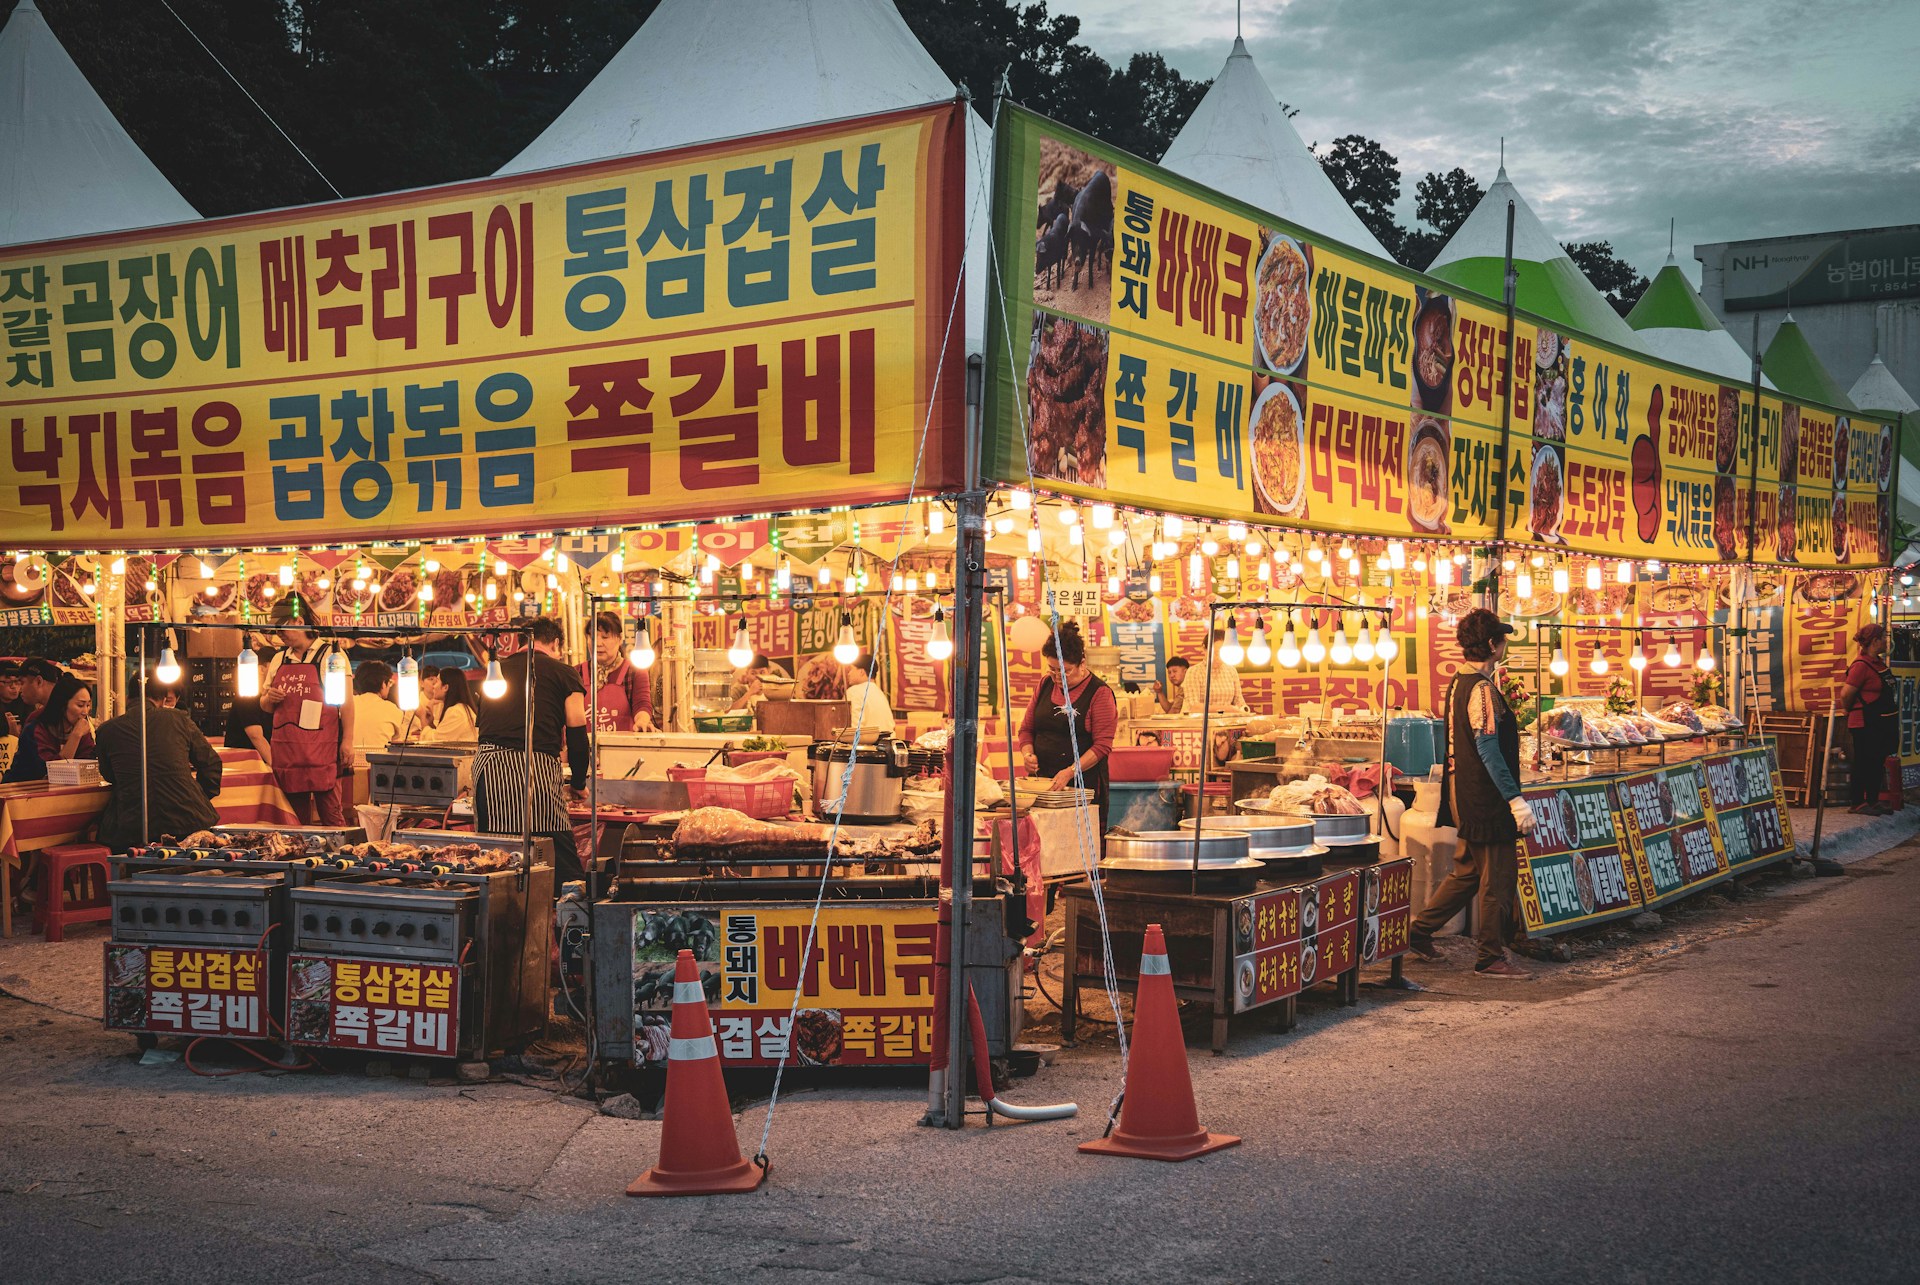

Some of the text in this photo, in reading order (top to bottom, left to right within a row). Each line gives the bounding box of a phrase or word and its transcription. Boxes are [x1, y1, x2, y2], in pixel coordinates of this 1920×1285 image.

[62, 142, 886, 383] 곰장어 메추리구이 통삼겹살
[1117, 190, 1154, 320] 통돼지
[1732, 254, 1769, 272] NH
[1, 264, 54, 388] 자갈치
[1156, 207, 1253, 345] 바베큐
[1313, 265, 1412, 391] 해물파전
[1569, 355, 1631, 446] 홍어회
[1668, 384, 1716, 461] 곰장어볶음
[1740, 402, 1780, 471] 더구이
[1799, 416, 1834, 480] 곱창볶음
[11, 328, 876, 532] 낙지볶음 곱창볶음 쪽갈비
[1114, 352, 1245, 491] 쪽갈비
[1309, 402, 1406, 514] 더덕파전
[1561, 461, 1627, 544] 도토리묵
[1666, 478, 1716, 549] 낙지볶음
[800, 604, 865, 649] 골뱅이침
[1074, 607, 1097, 615] 입니다
[1234, 595, 1417, 637] 홍어회
[898, 619, 938, 709] 곱창볶음
[1115, 625, 1157, 687] 닭똥집
[1504, 619, 1556, 695] 해물파
[1795, 604, 1853, 711] 장터국밥
[1573, 791, 1616, 840] 도토리묵
[1630, 780, 1665, 831] 곱창볶음
[1700, 790, 1727, 869] 홍어회
[1754, 806, 1785, 850] 고추전
[1533, 853, 1630, 917] 해물파전 더덕파전
[1625, 810, 1656, 899] 홍어삼합
[1324, 881, 1354, 923] 곰탕
[149, 949, 454, 1010] 통삼겹살 통삼겹살
[724, 914, 759, 1006] 통돼지
[762, 922, 938, 997] 바베큐
[1258, 951, 1298, 995] 잔치국수
[1322, 929, 1351, 970] 수육
[150, 990, 449, 1052] 쪽갈비 쪽갈비
[712, 1014, 791, 1059] 겹살
